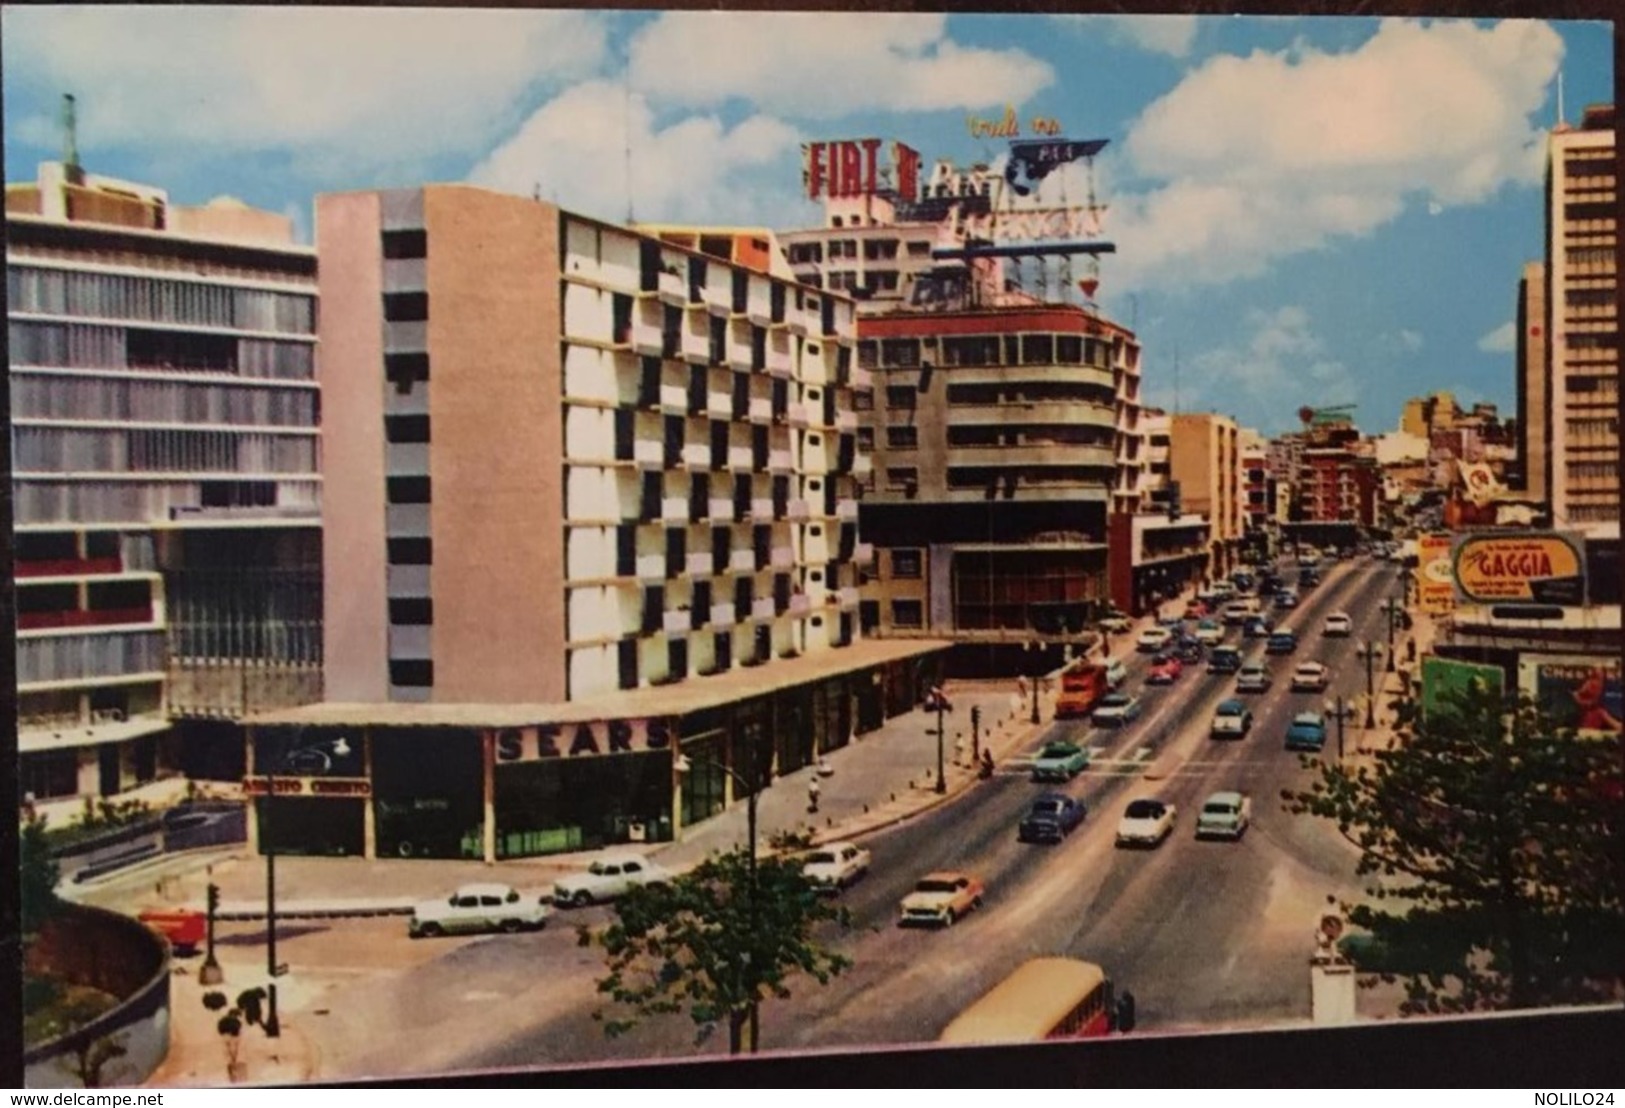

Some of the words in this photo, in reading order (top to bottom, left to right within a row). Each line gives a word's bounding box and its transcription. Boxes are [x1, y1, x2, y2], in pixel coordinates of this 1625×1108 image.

[806, 139, 882, 199] FIAT
[1478, 552, 1553, 577] GAGGIA
[497, 719, 671, 761] SEARS
